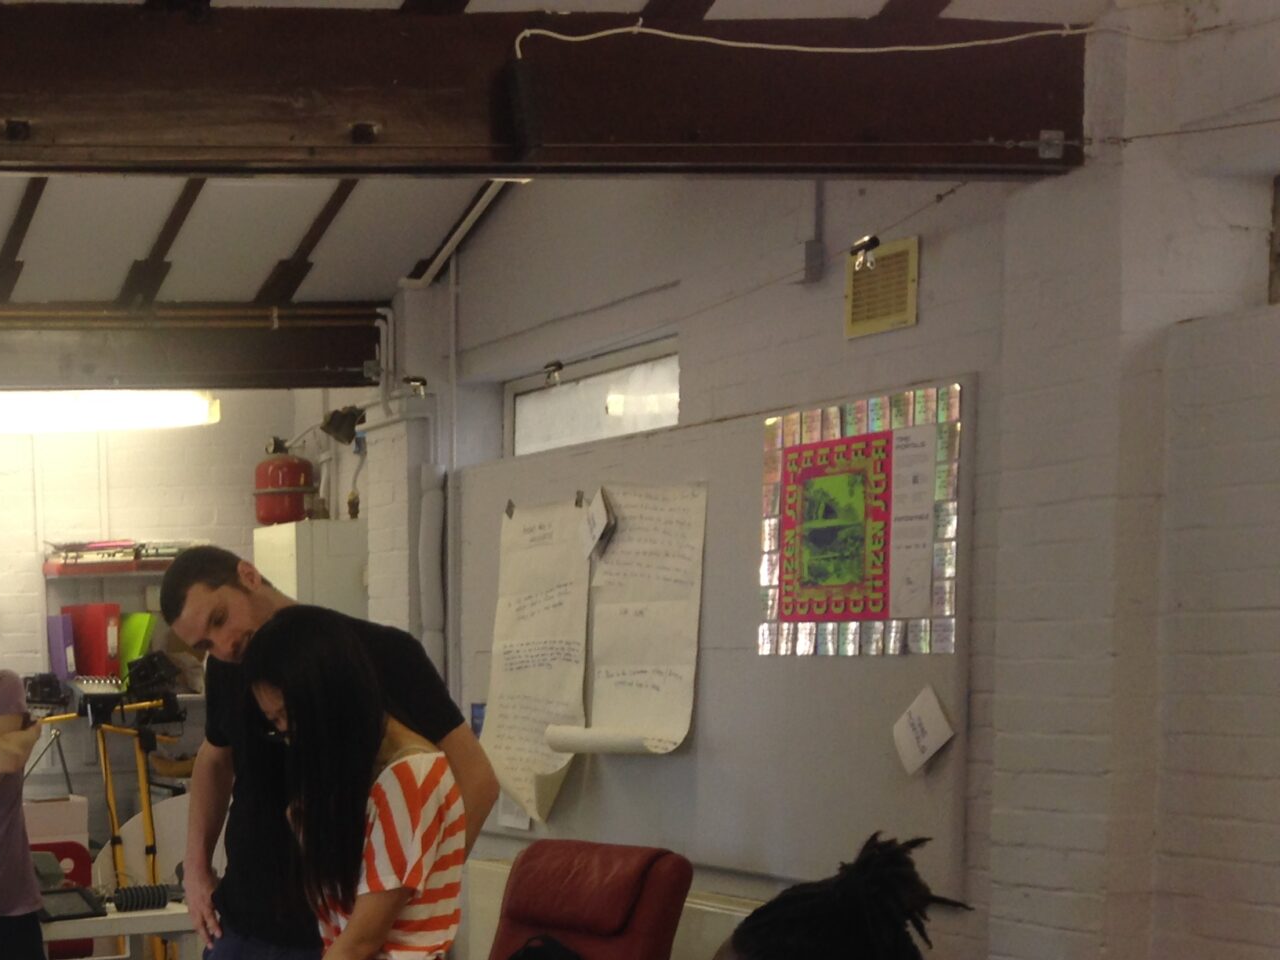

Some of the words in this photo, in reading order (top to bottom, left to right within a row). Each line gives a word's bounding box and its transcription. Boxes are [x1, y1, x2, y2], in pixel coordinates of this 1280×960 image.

[783, 449, 799, 521] SCI-FI
[870, 438, 888, 512] SCI-FI
[782, 527, 796, 616] CITIZEN
[868, 521, 886, 613] CITIZEN
